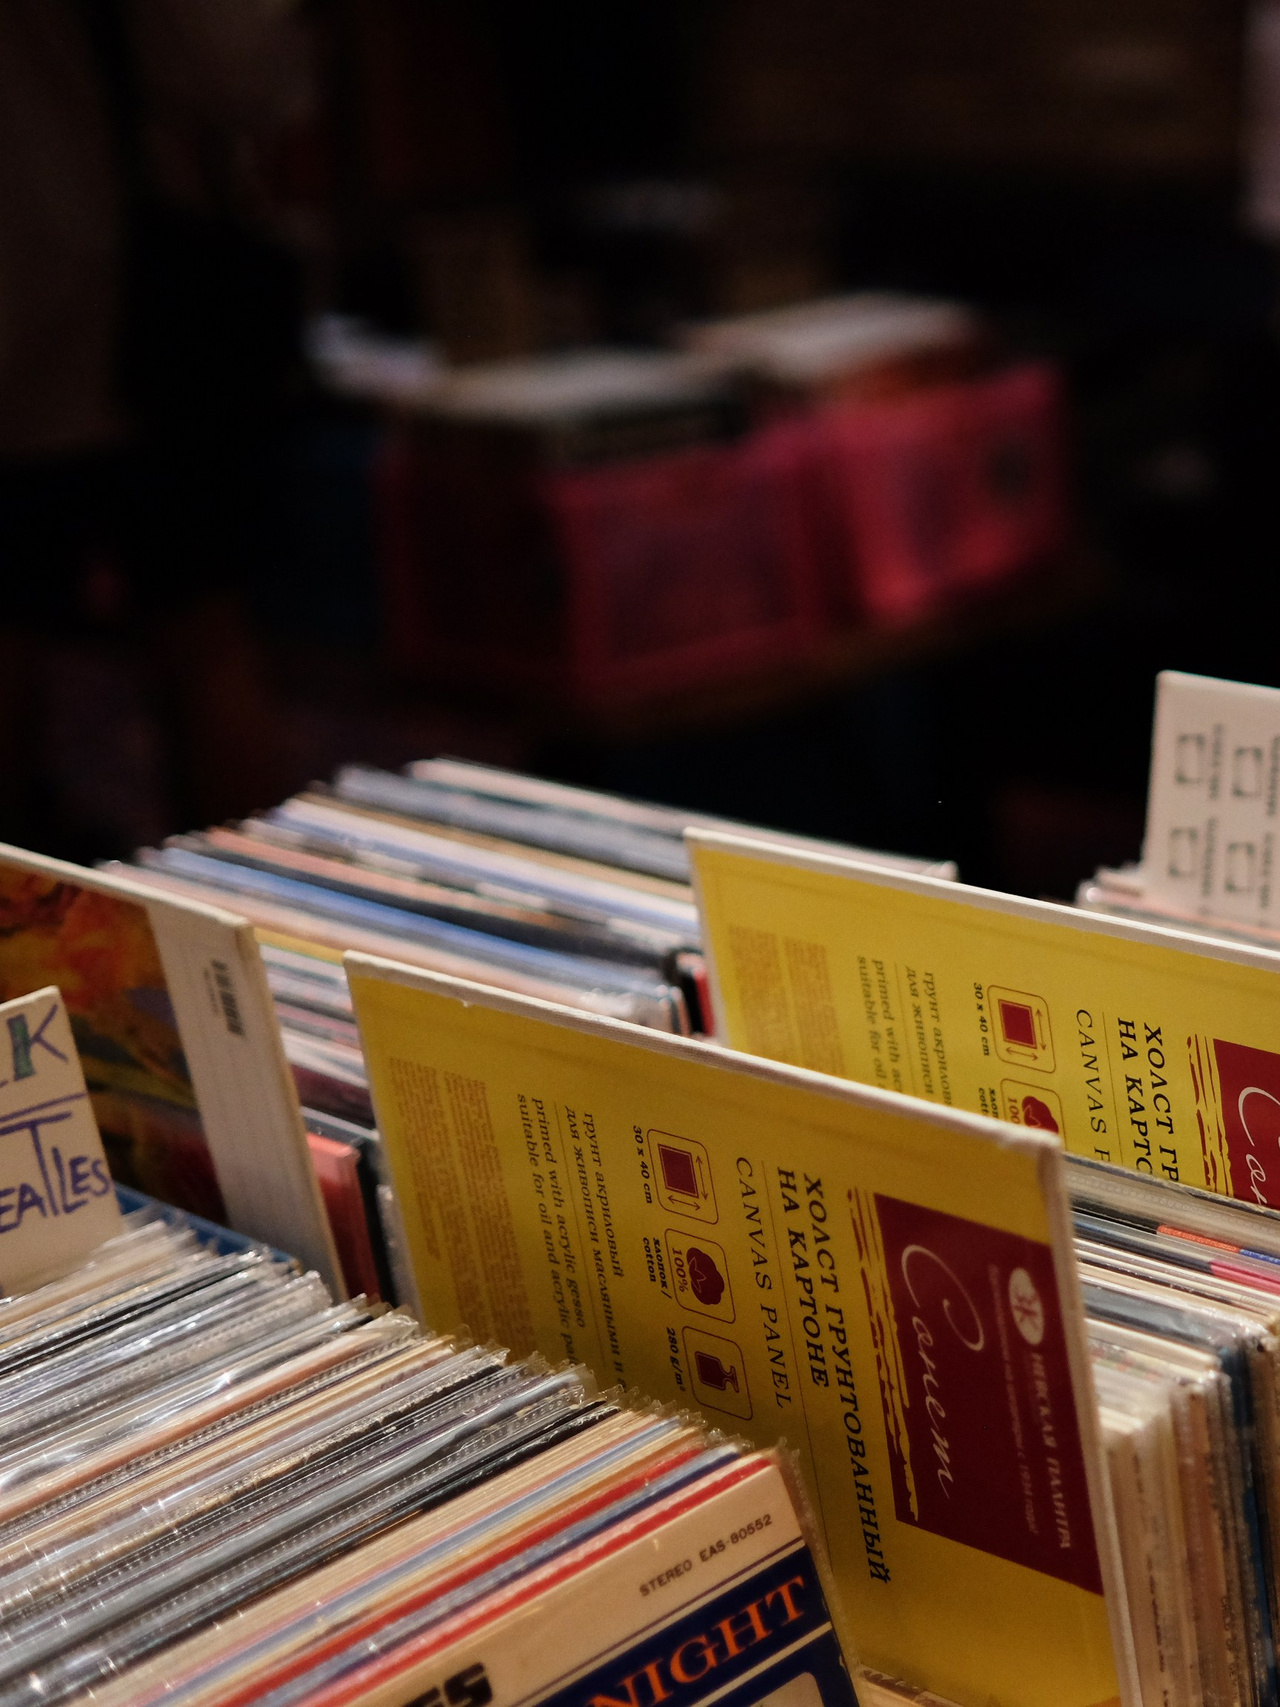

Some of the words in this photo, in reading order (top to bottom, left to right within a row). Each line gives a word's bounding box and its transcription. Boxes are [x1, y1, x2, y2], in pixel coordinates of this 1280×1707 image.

[857, 956, 876, 1027] suitable
[906, 966, 920, 998] для
[925, 972, 941, 1022] грунт
[974, 982, 984, 999] 30
[872, 959, 895, 1021] primed
[886, 1027, 901, 1064] with
[979, 1015, 988, 1033] 40
[868, 1030, 882, 1051] for
[911, 1004, 934, 1094] живописи
[981, 1037, 989, 1056] cm
[1117, 1018, 1138, 1060] НА
[874, 1057, 887, 1081] oil
[1076, 1009, 1107, 1133] CANVAS
[1144, 1023, 1174, 1134] ХОЛСТ
[979, 1087, 989, 1116] cott
[989, 1088, 999, 1119] хлоп
[1007, 1097, 1021, 1125] 100
[1125, 1074, 1153, 1175] КАРТО
[517, 1094, 539, 1167] suitable
[532, 1097, 558, 1165] primed
[633, 1125, 643, 1143] 30
[0, 1111, 112, 1234] EATLES
[532, 1172, 544, 1195] for
[549, 1170, 563, 1208] with
[639, 1160, 650, 1182] 40
[777, 1167, 800, 1213] НА
[538, 1203, 553, 1226] oil
[584, 1112, 602, 1167] грунт
[595, 1171, 624, 1278] акриловый
[643, 1185, 652, 1204] cm
[545, 1231, 560, 1265] and
[556, 1213, 575, 1274] acrylic
[565, 1105, 580, 1142] для
[574, 1146, 599, 1245] живописи
[592, 1249, 621, 1357] масляными
[614, 1362, 623, 1374] и
[643, 1237, 656, 1282] cotton
[672, 1248, 688, 1293] 100%
[736, 1157, 773, 1290] CANVAS
[760, 1304, 791, 1408] PANEL
[548, 1269, 569, 1329] acrylic
[565, 1276, 585, 1328] gesso
[788, 1228, 829, 1388] КАРТОНЕ
[560, 1332, 577, 1365] pai
[666, 1327, 678, 1352] 280
[804, 1173, 839, 1293] ХОЛСТ
[826, 1304, 891, 1584] ГРУНТОВАННЫЙ
[902, 1245, 985, 1499] Сонет
[640, 1559, 693, 1597] STEREO
[700, 1514, 772, 1562] EAS-80552
[588, 1575, 806, 1707] NIGHT
